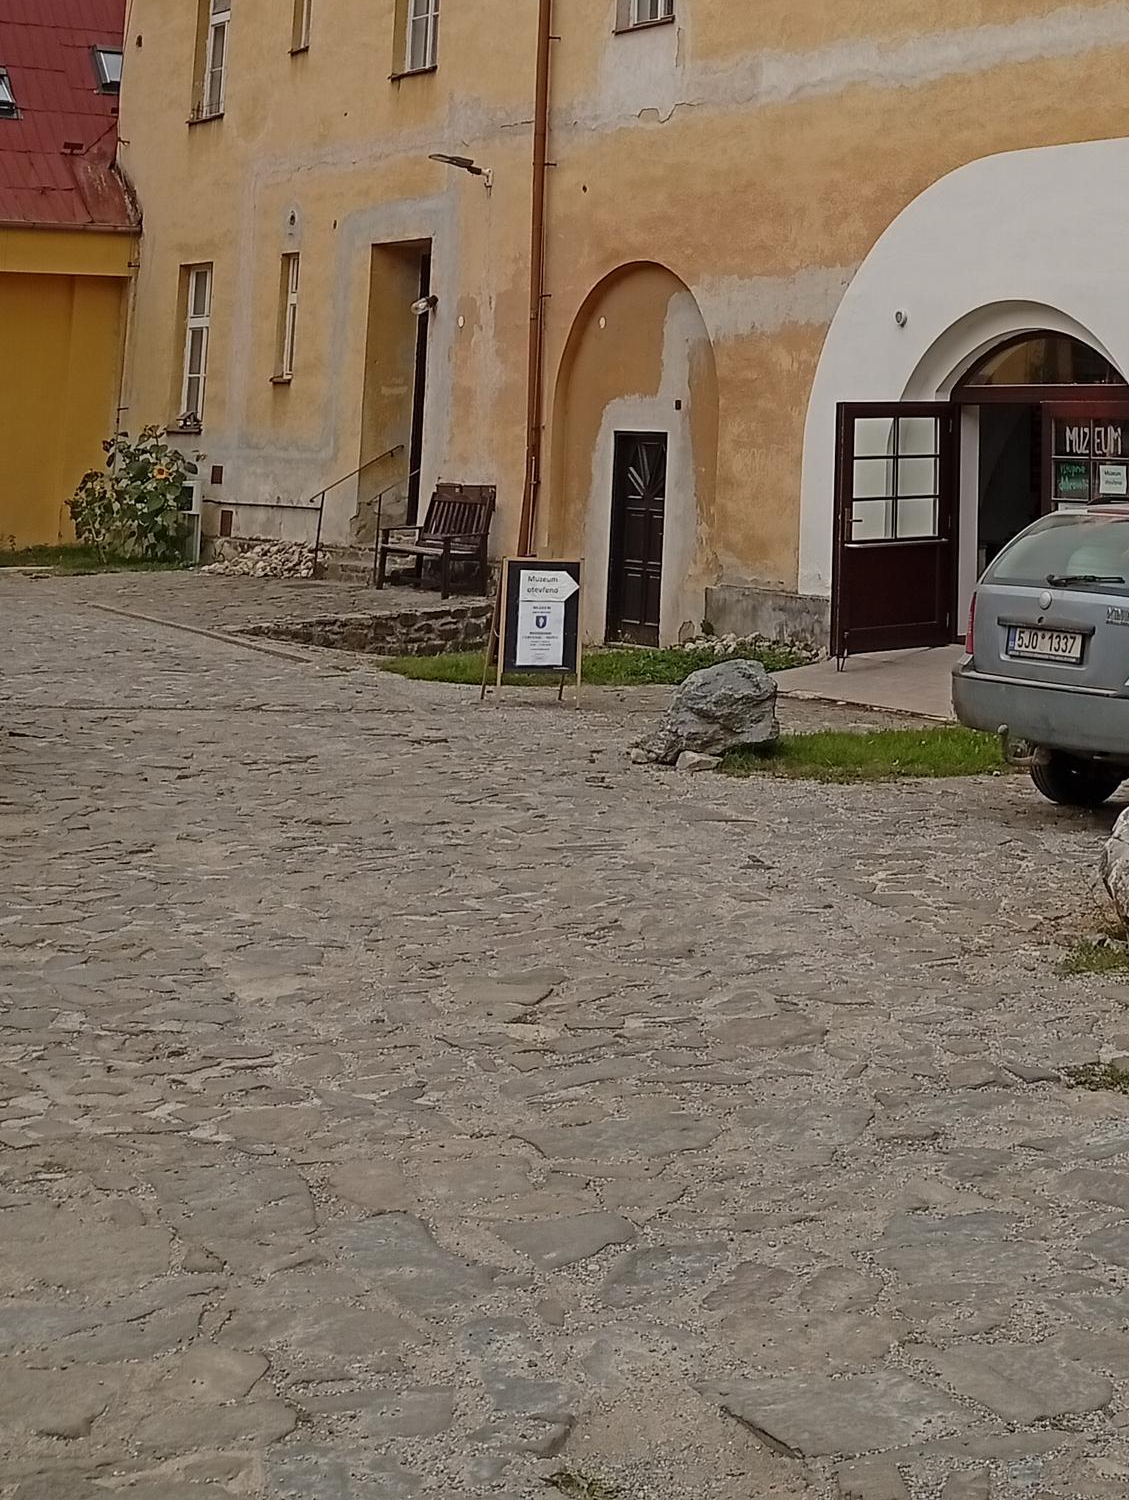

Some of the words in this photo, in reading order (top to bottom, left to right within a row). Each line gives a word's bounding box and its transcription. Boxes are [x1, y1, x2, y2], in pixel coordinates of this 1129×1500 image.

[1065, 425, 1122, 455] MUZEUM
[1018, 630, 1039, 649] 5J0
[1048, 633, 1076, 653] 1337
